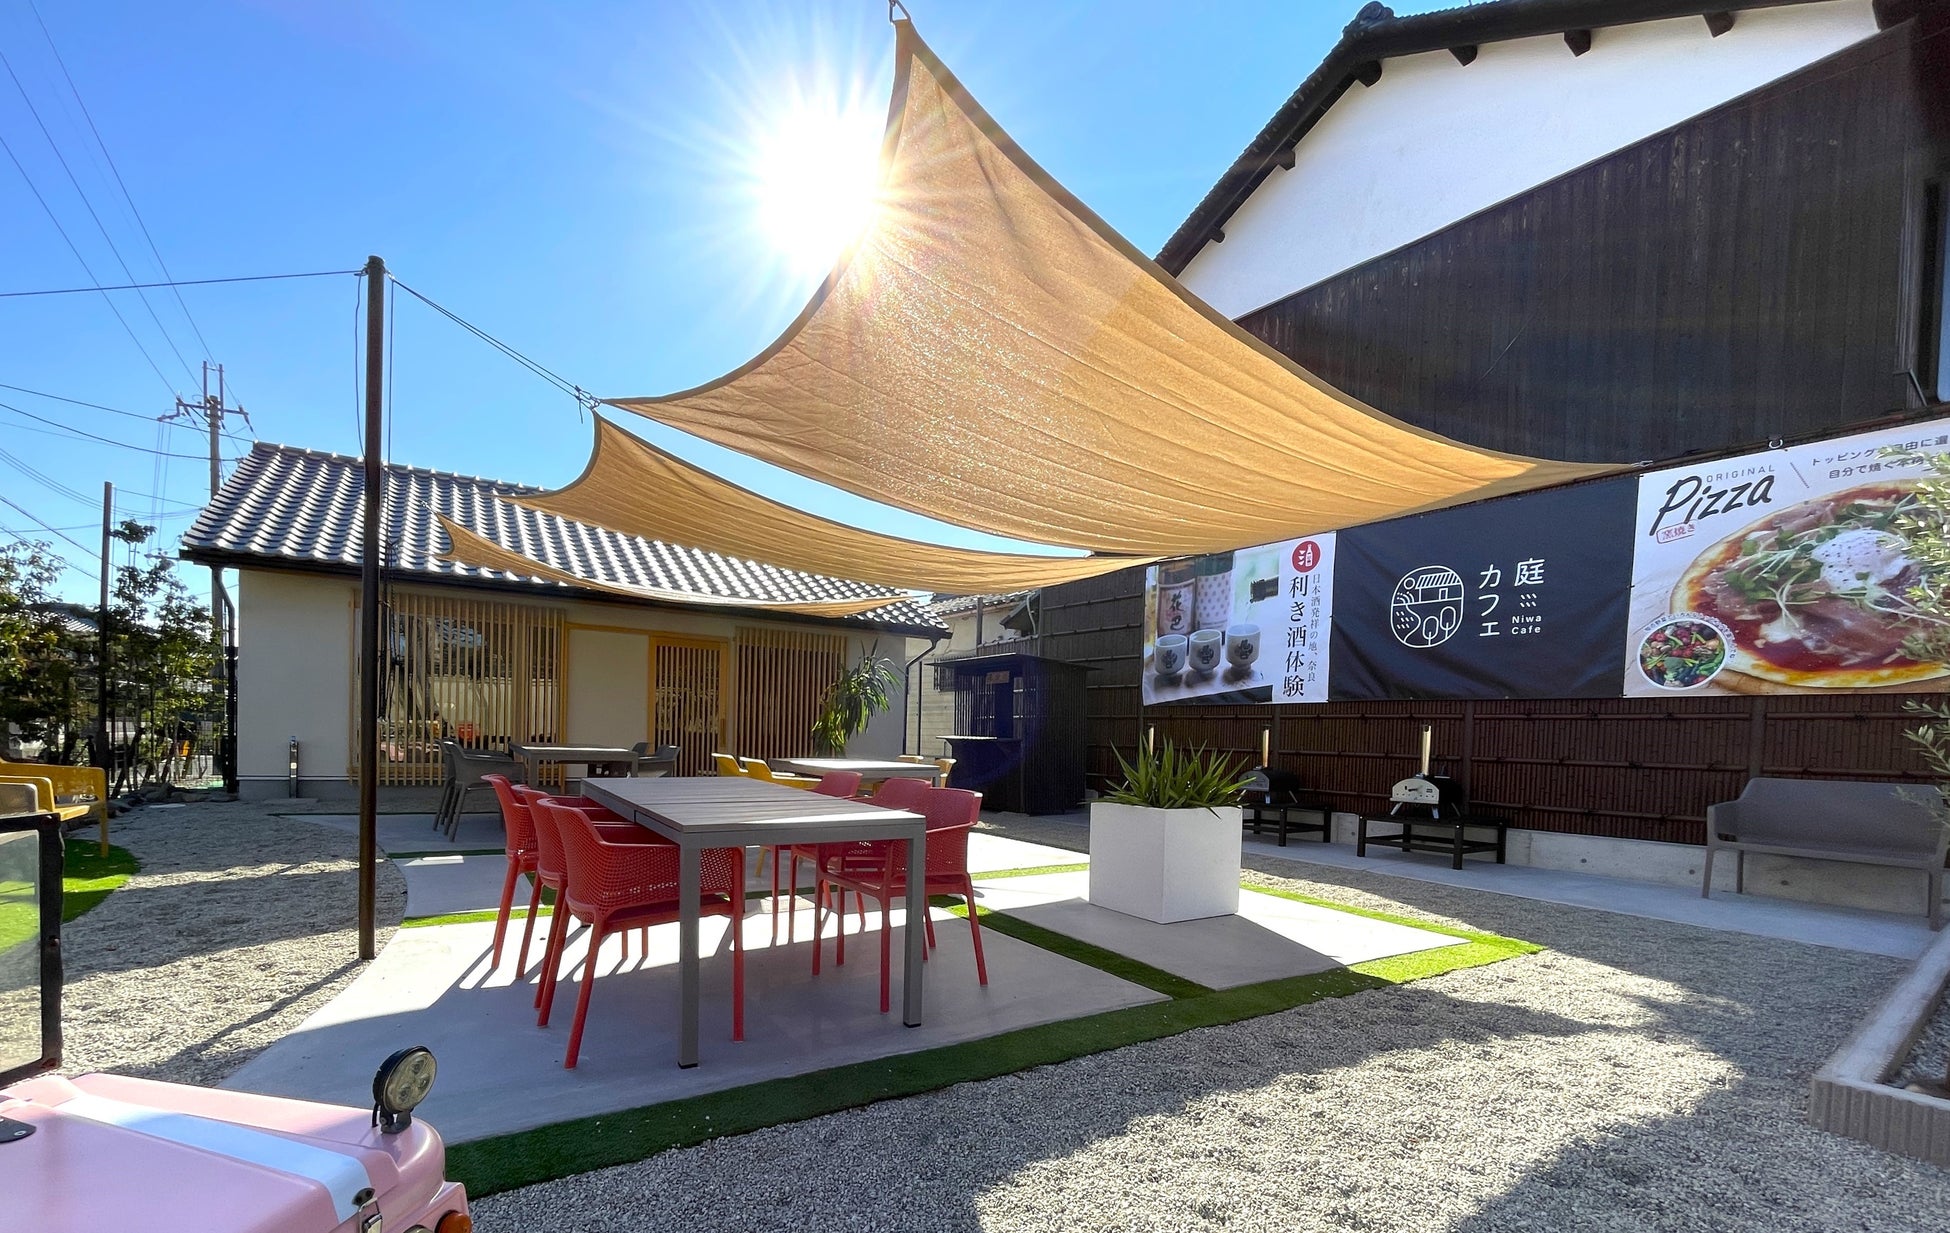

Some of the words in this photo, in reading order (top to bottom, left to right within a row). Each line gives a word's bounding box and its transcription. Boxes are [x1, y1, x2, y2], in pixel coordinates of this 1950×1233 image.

[1706, 464, 1775, 483] ORIGINAL
[1649, 475, 1775, 536] Pizza
[1514, 557, 1545, 587] 庭
[1478, 563, 1501, 637] カフェ
[1511, 614, 1542, 624] Niwa
[1282, 574, 1309, 698] 利き酒体験
[1307, 573, 1321, 682] 日本酒発祥の地、奈良
[1511, 625, 1541, 635] Cafe
